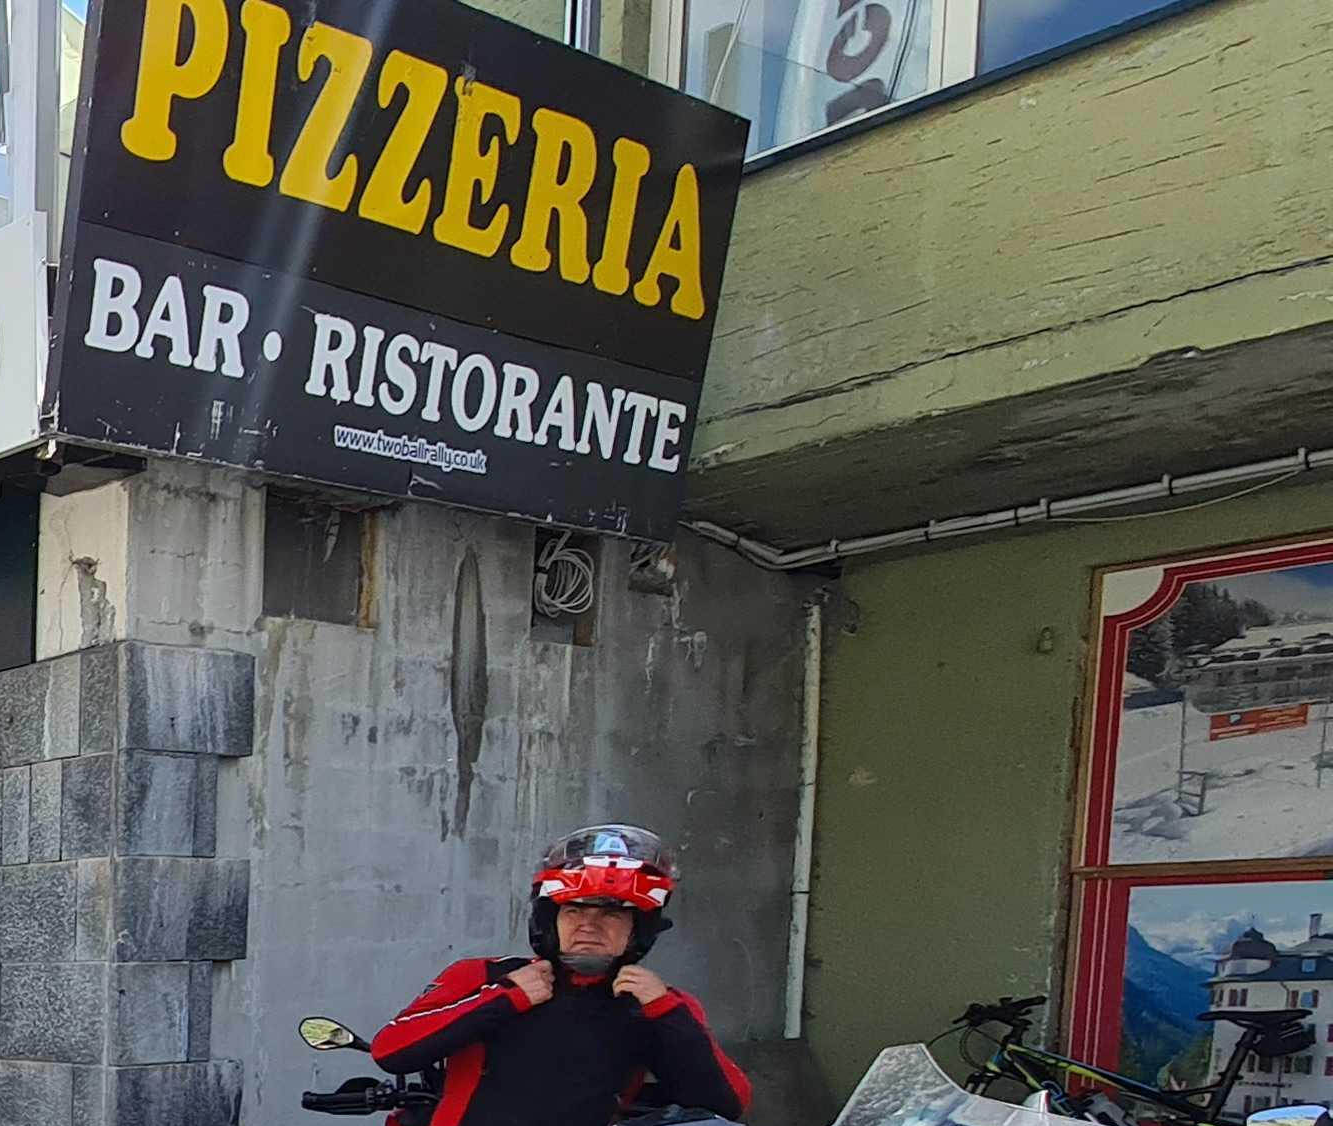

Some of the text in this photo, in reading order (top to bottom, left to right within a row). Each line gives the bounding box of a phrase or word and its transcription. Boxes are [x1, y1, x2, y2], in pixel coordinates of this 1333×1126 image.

[120, 0, 707, 320] PIZZERIA
[84, 257, 687, 474] BAR RISTORANTE
[334, 424, 488, 475] www.twoballrally.co.uk
